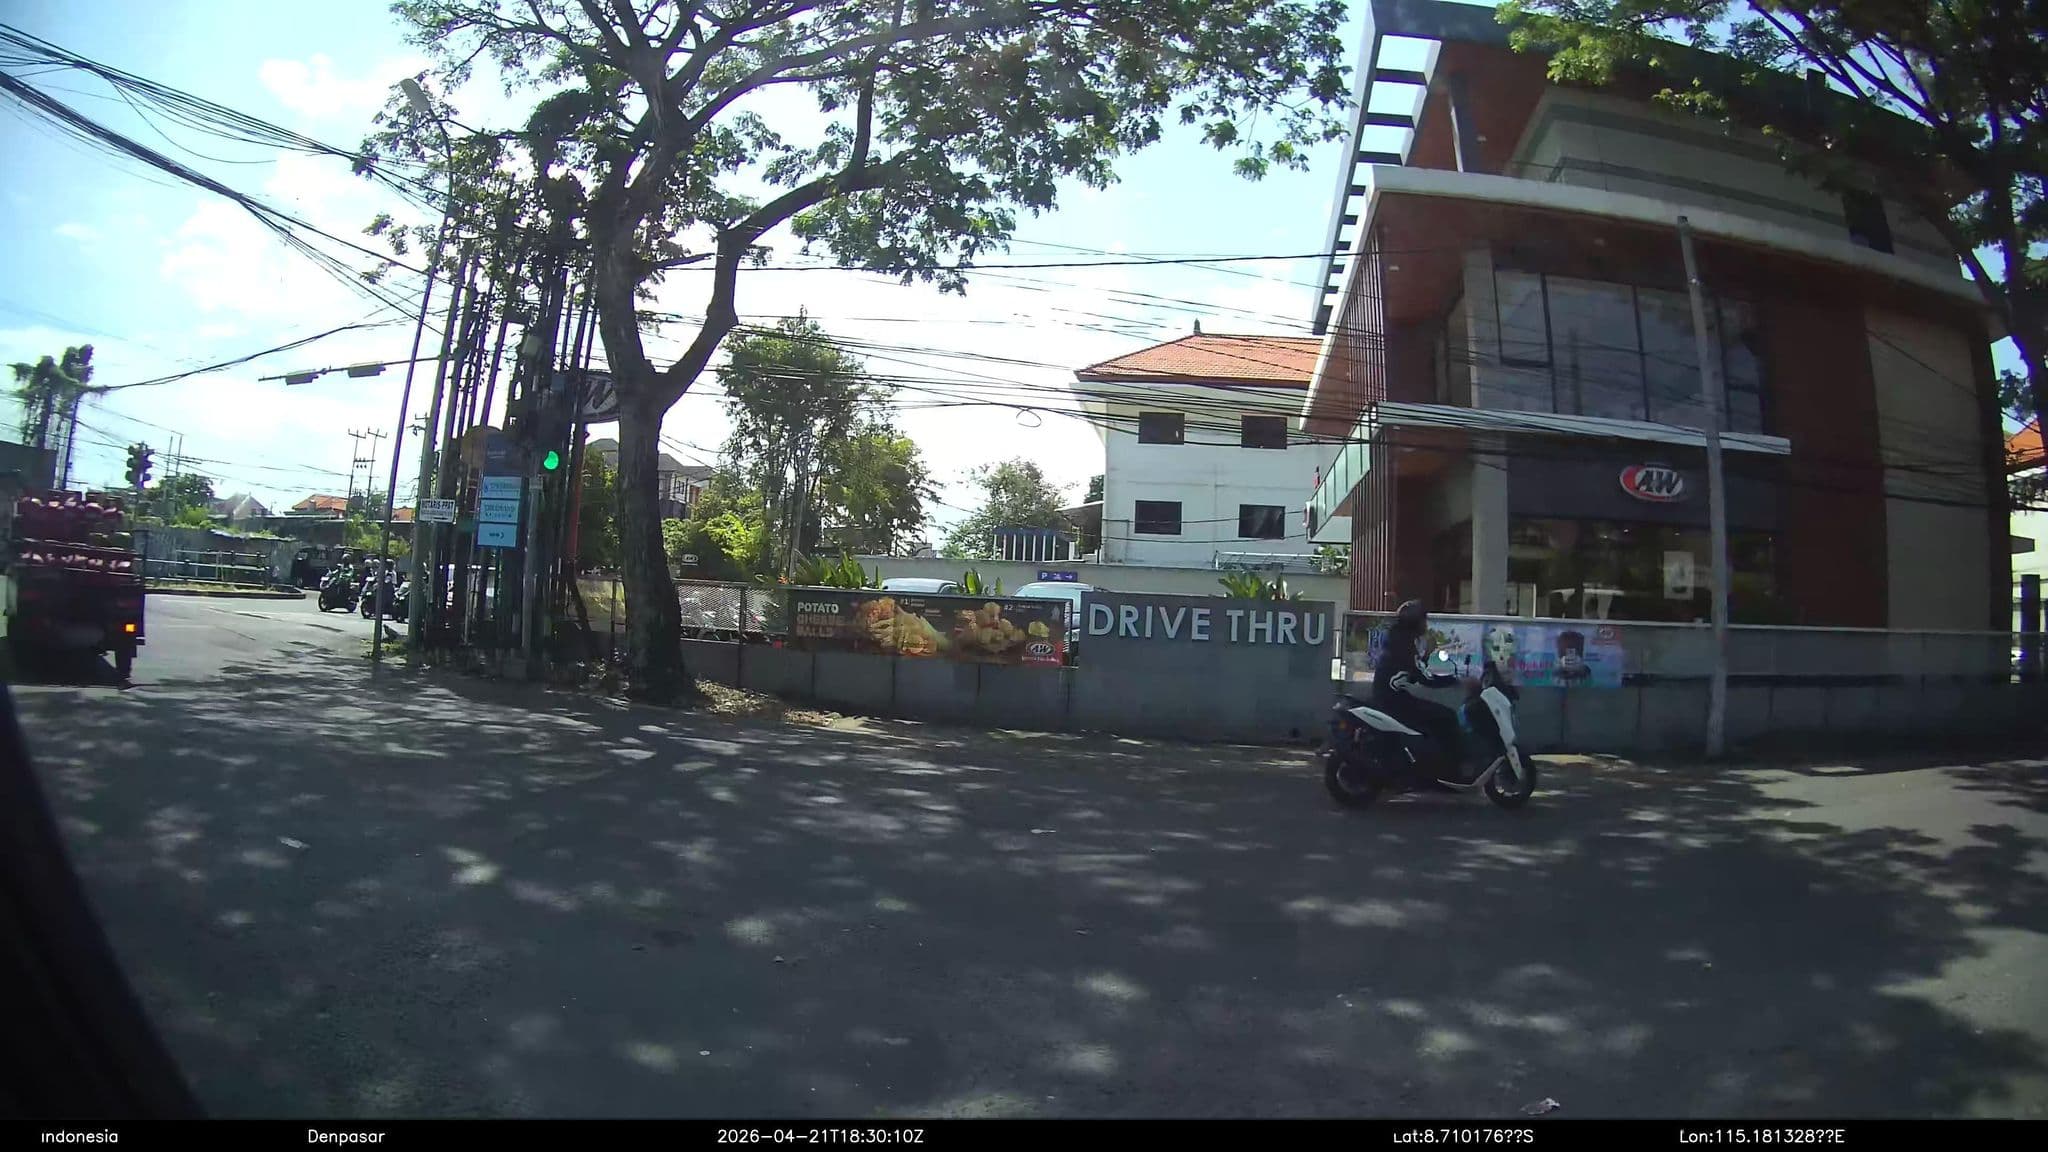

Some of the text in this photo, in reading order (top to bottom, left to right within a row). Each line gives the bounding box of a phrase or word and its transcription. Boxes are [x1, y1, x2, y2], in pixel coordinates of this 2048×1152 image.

[797, 601, 840, 614] POTATO
[1088, 602, 1210, 641] DRIVE
[1225, 609, 1326, 646] THRU
